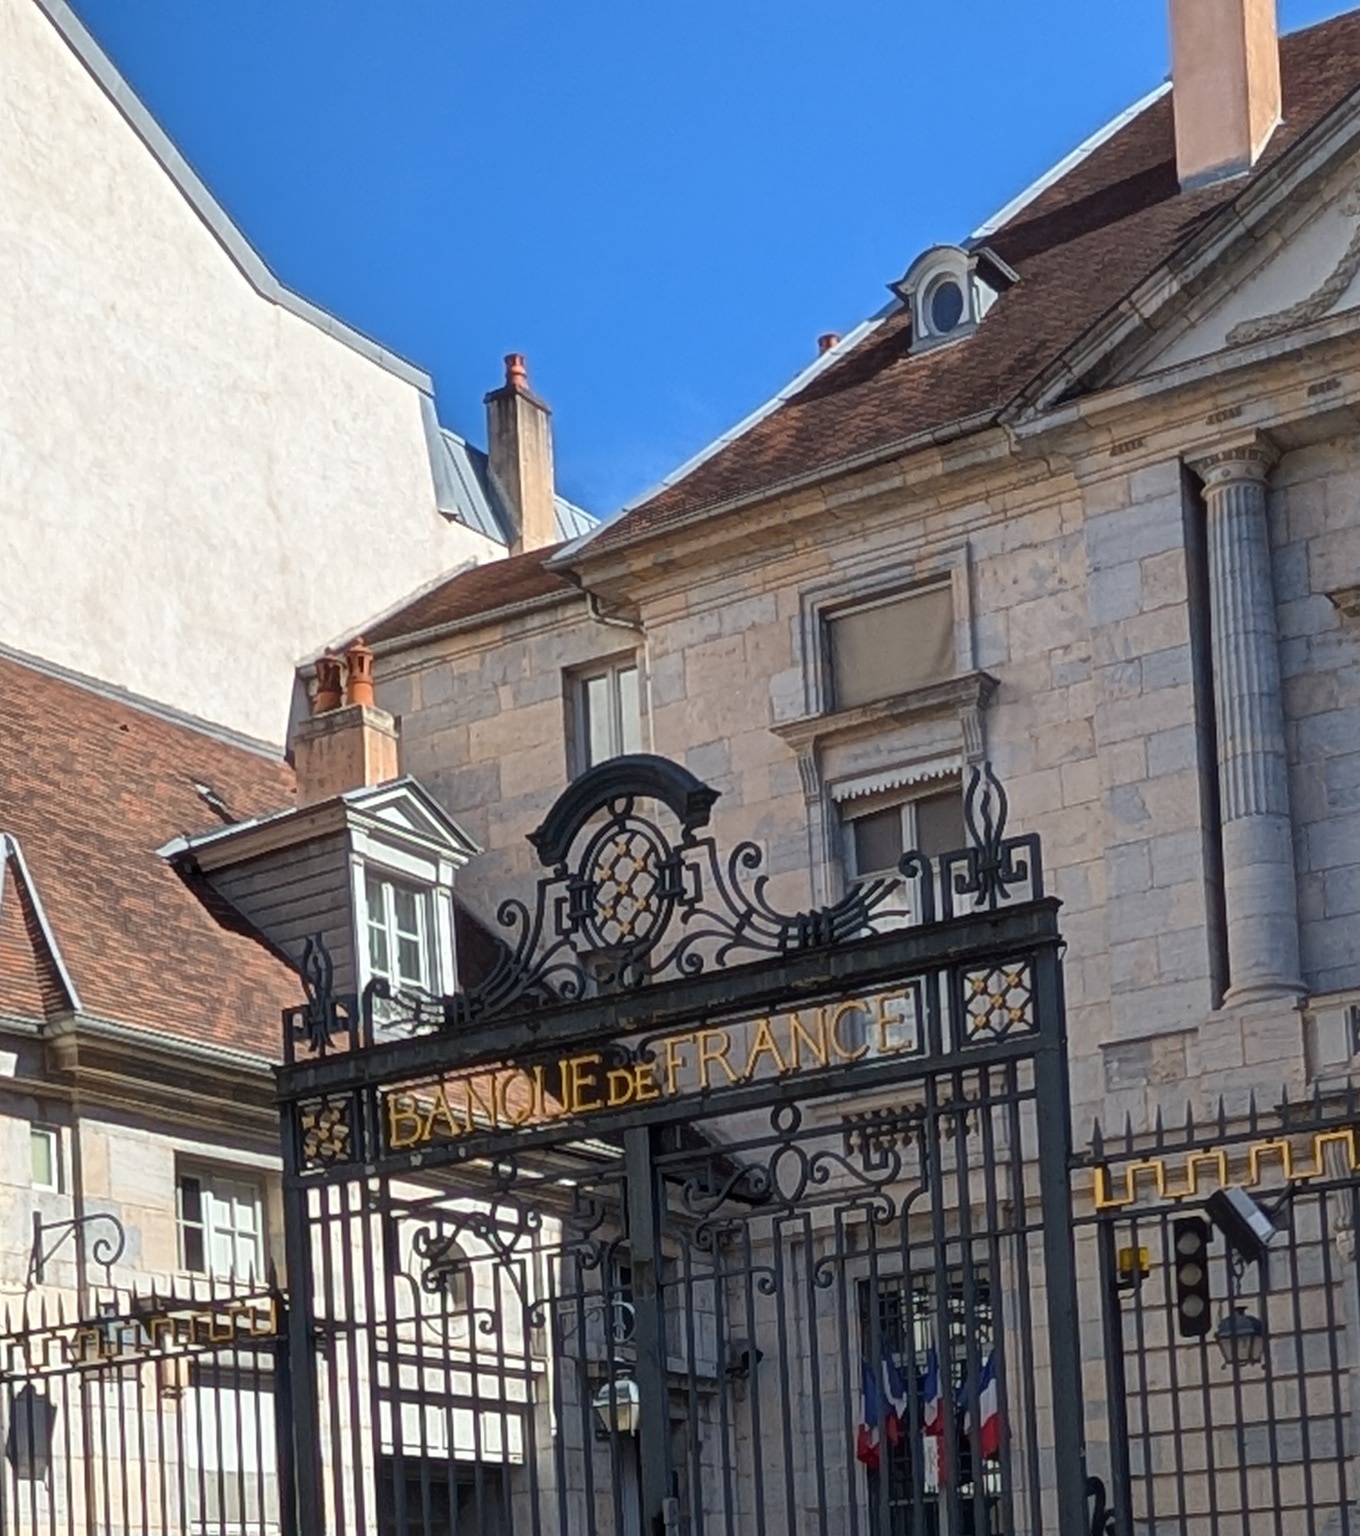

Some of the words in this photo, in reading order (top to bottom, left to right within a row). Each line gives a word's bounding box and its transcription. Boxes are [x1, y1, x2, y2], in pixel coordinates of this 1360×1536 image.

[387, 1054, 600, 1148] BANQUE
[606, 1063, 659, 1106] DE
[662, 989, 912, 1096] FRANCE
